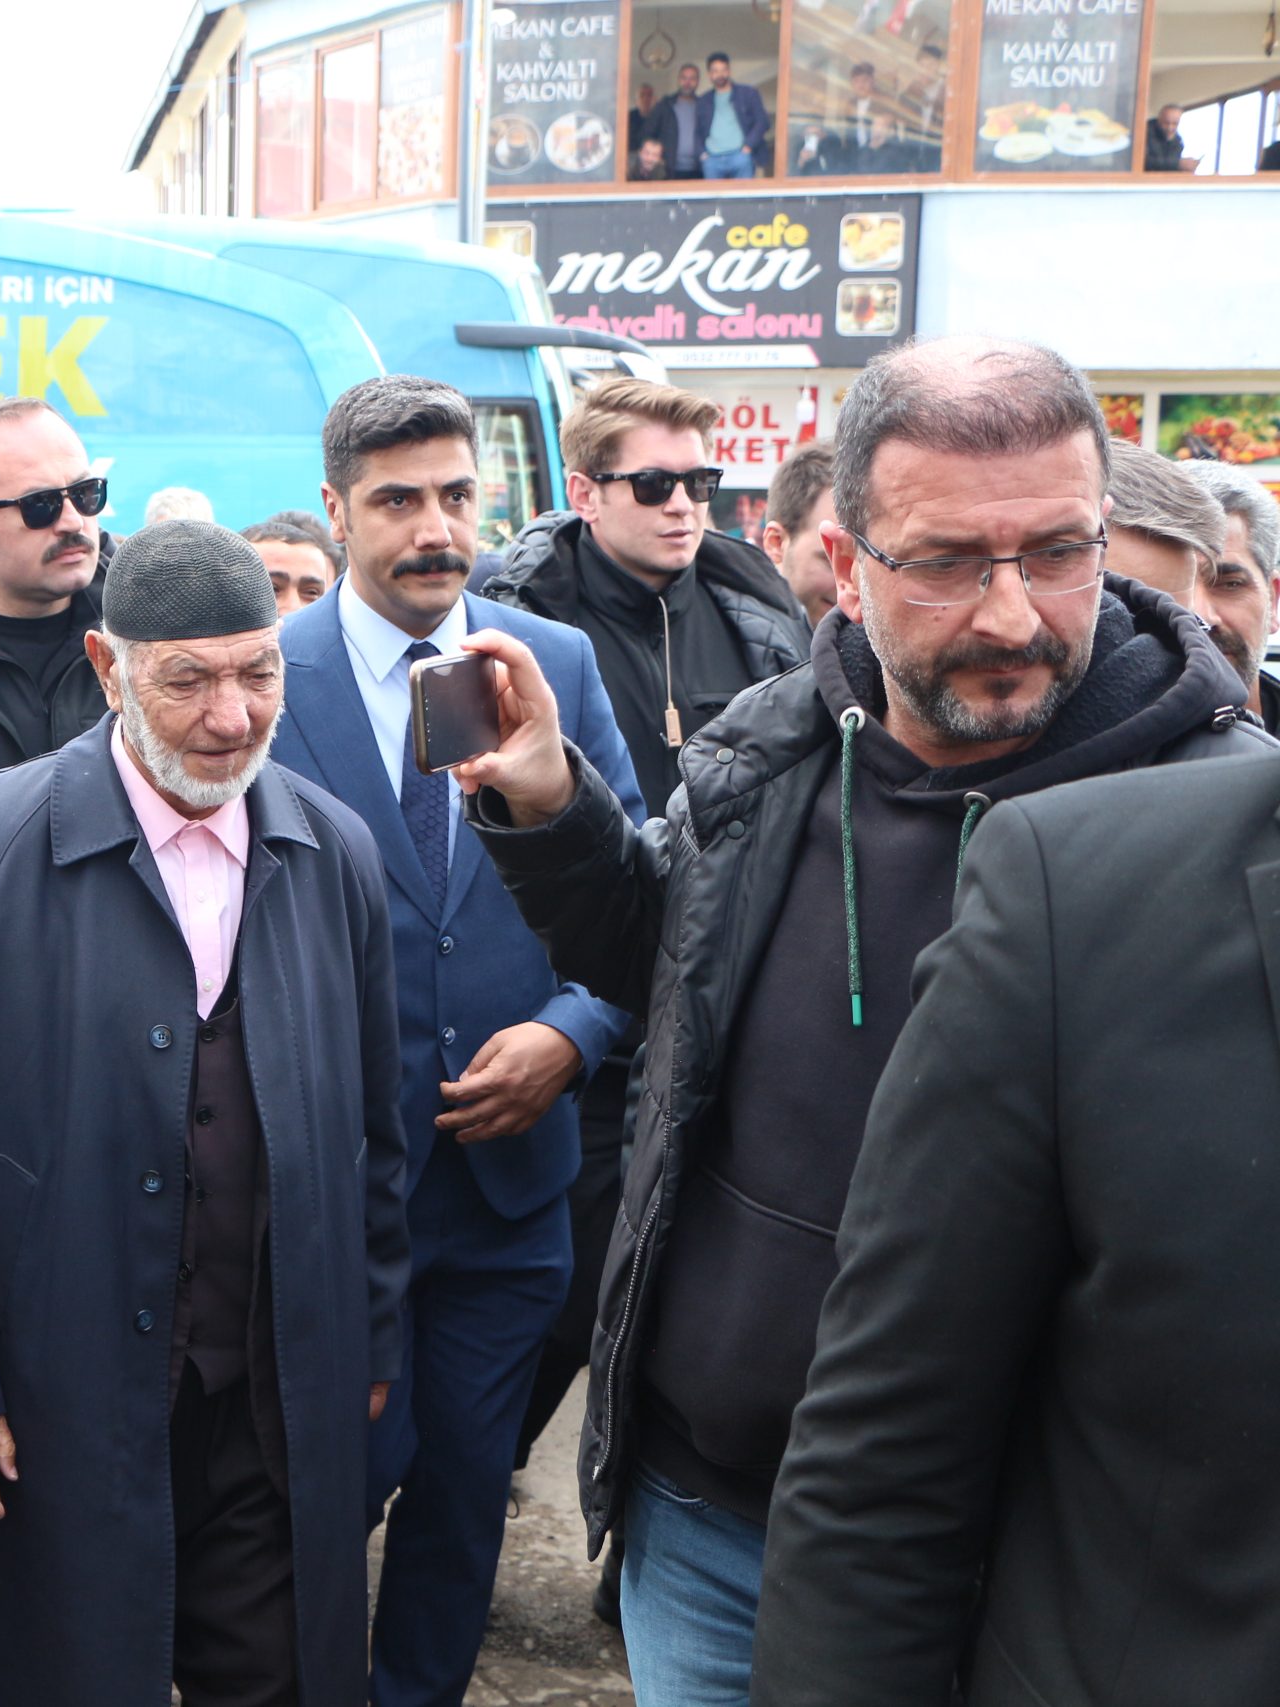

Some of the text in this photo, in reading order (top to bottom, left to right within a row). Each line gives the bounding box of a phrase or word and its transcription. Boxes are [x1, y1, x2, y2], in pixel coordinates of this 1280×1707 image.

[986, 0, 1139, 15] MEKAN CAFE
[561, 15, 615, 37] CAFE
[1051, 18, 1068, 39] &
[538, 40, 554, 60] &
[1002, 41, 1117, 64] KAHVALTI
[496, 59, 597, 83] KAHVALTI
[1009, 65, 1105, 88] SALONU
[503, 81, 588, 104] SALONU
[726, 213, 810, 249] cafe
[547, 215, 822, 316] mekan
[697, 303, 822, 340] salonu
[715, 437, 790, 463] KET
